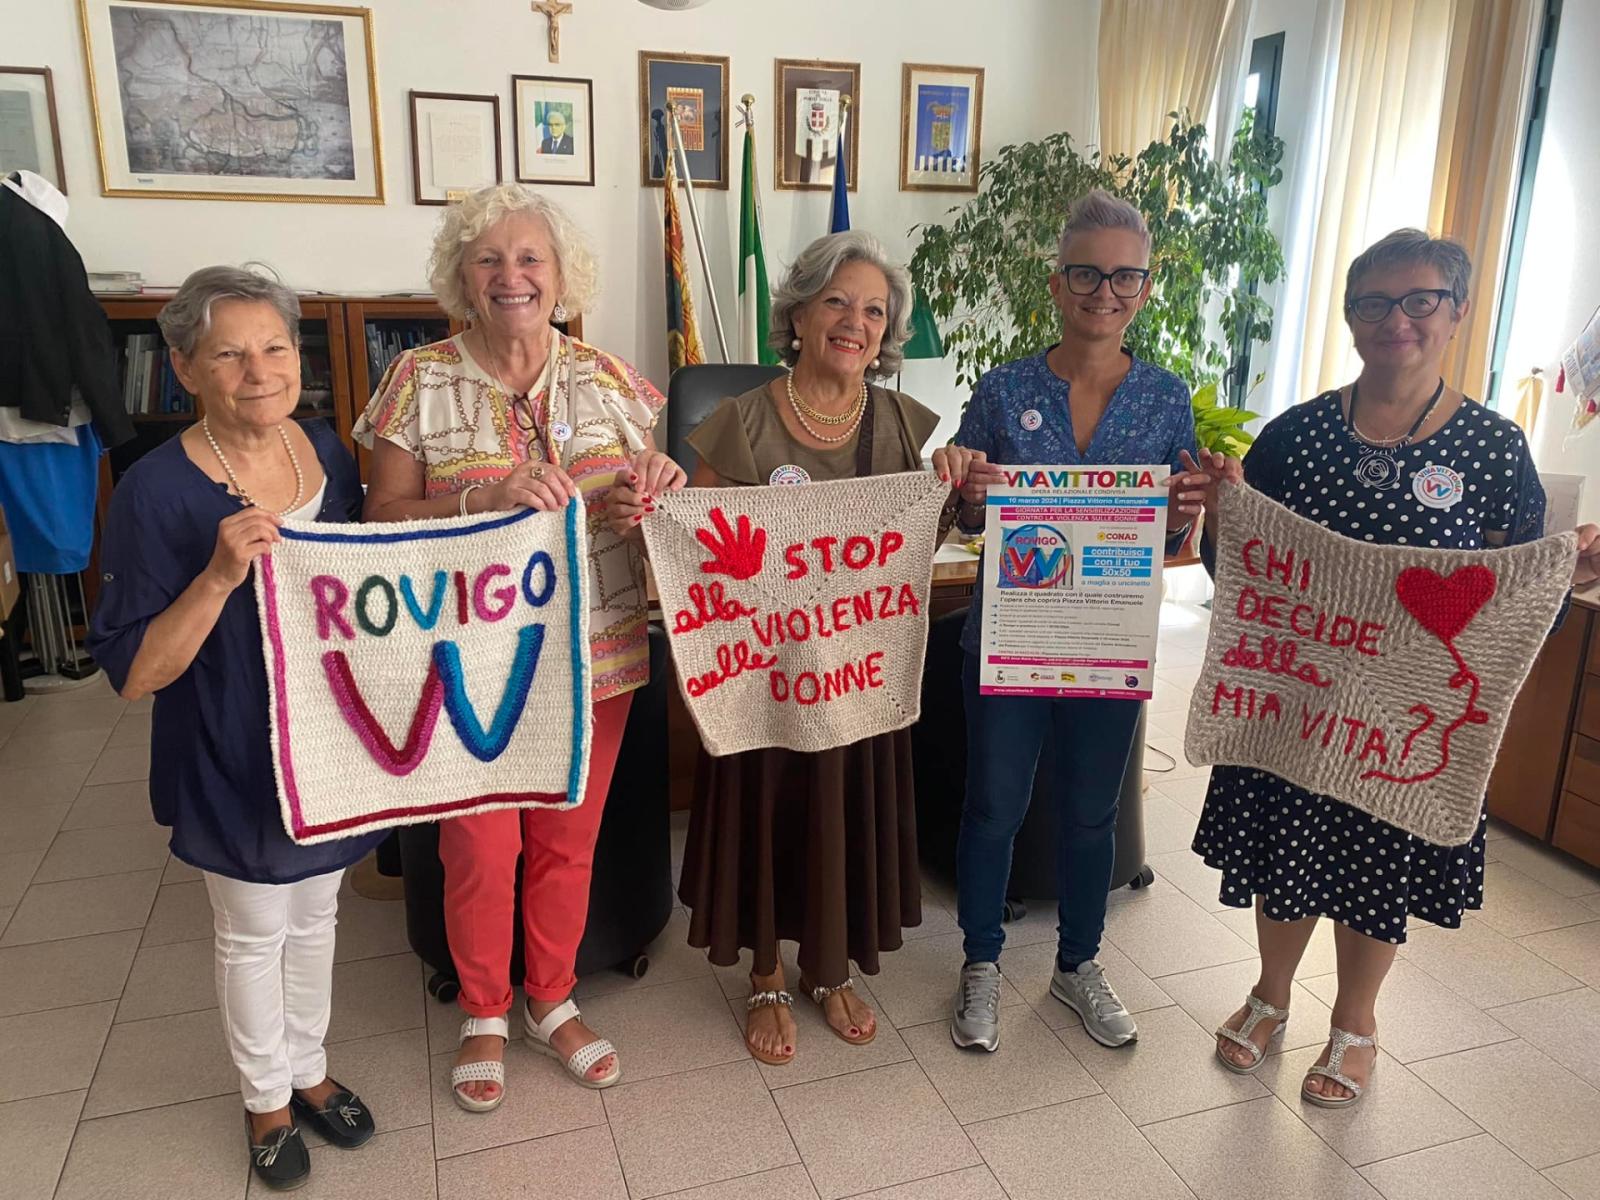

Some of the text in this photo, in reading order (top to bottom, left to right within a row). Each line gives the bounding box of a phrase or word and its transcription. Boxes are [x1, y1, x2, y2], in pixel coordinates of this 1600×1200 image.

[785, 530, 905, 580] STOP
[1016, 536, 1058, 545] ROVIGO
[1090, 548, 1145, 556] contribuisci
[1105, 533, 1138, 541] CONAD
[1087, 579, 1110, 587] maglia
[1117, 579, 1151, 587] uncinetto
[1101, 568, 1132, 577] 50x50
[1241, 538, 1311, 593] CHI
[310, 550, 557, 641] ROVIGO
[672, 580, 920, 647] alla VIOLENZA
[1236, 586, 1386, 657] DECIDE
[686, 640, 885, 706] sulle DONNE
[1221, 632, 1333, 689] della
[1211, 681, 1282, 722] MIA
